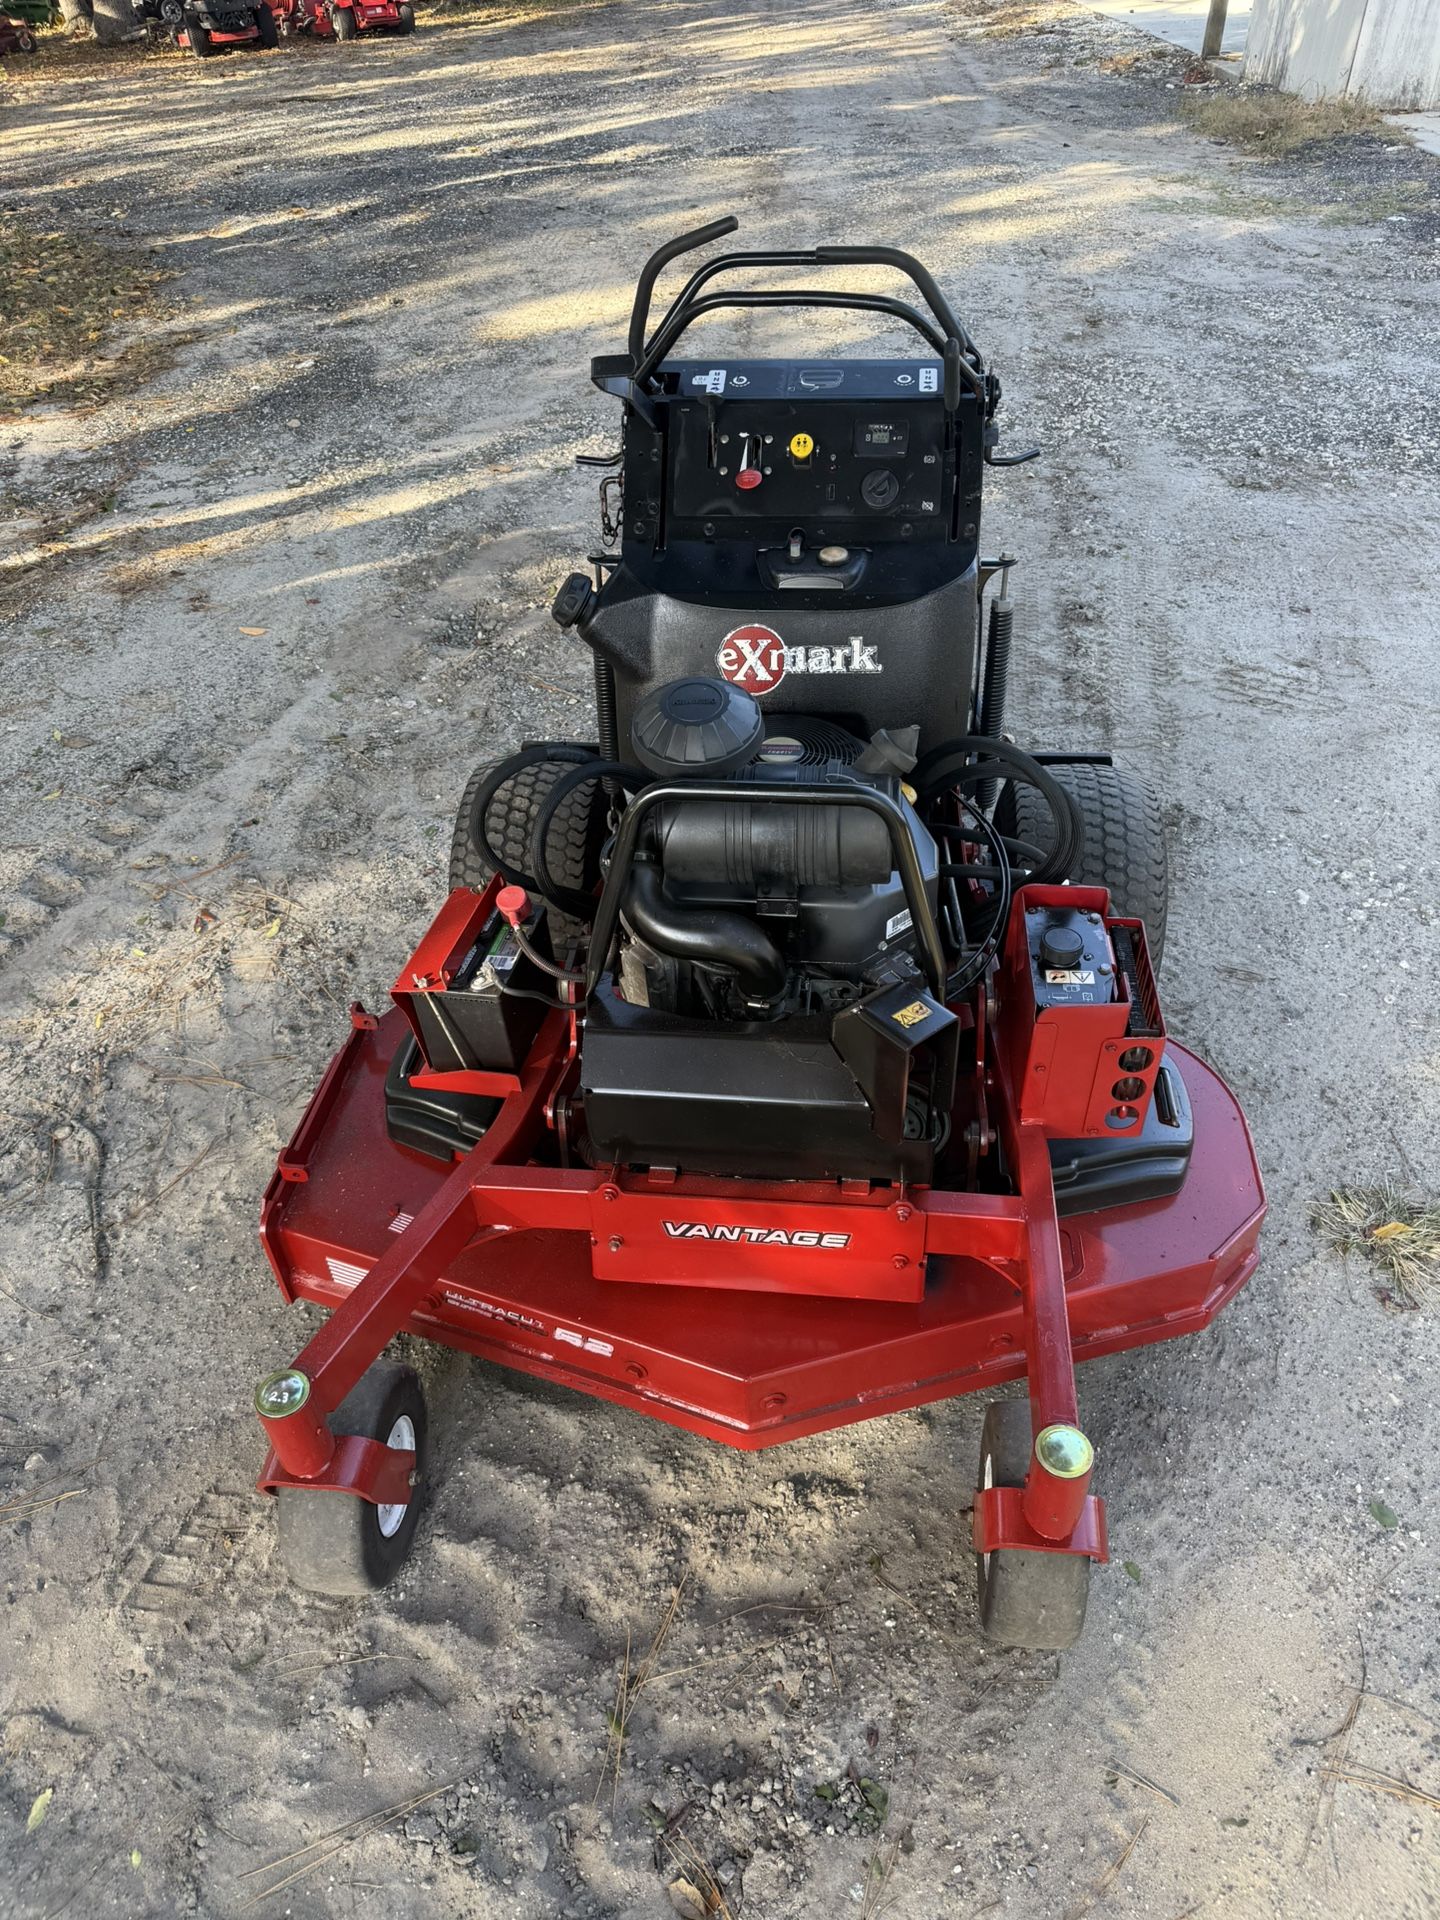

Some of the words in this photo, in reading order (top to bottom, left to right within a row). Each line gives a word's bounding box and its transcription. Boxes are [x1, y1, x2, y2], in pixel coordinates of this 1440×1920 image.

[718, 635, 881, 682] eXmark
[663, 1221, 850, 1248] VANTAGE
[445, 1289, 546, 1329] ULTRACUT
[268, 1390, 289, 1404] 2.3
